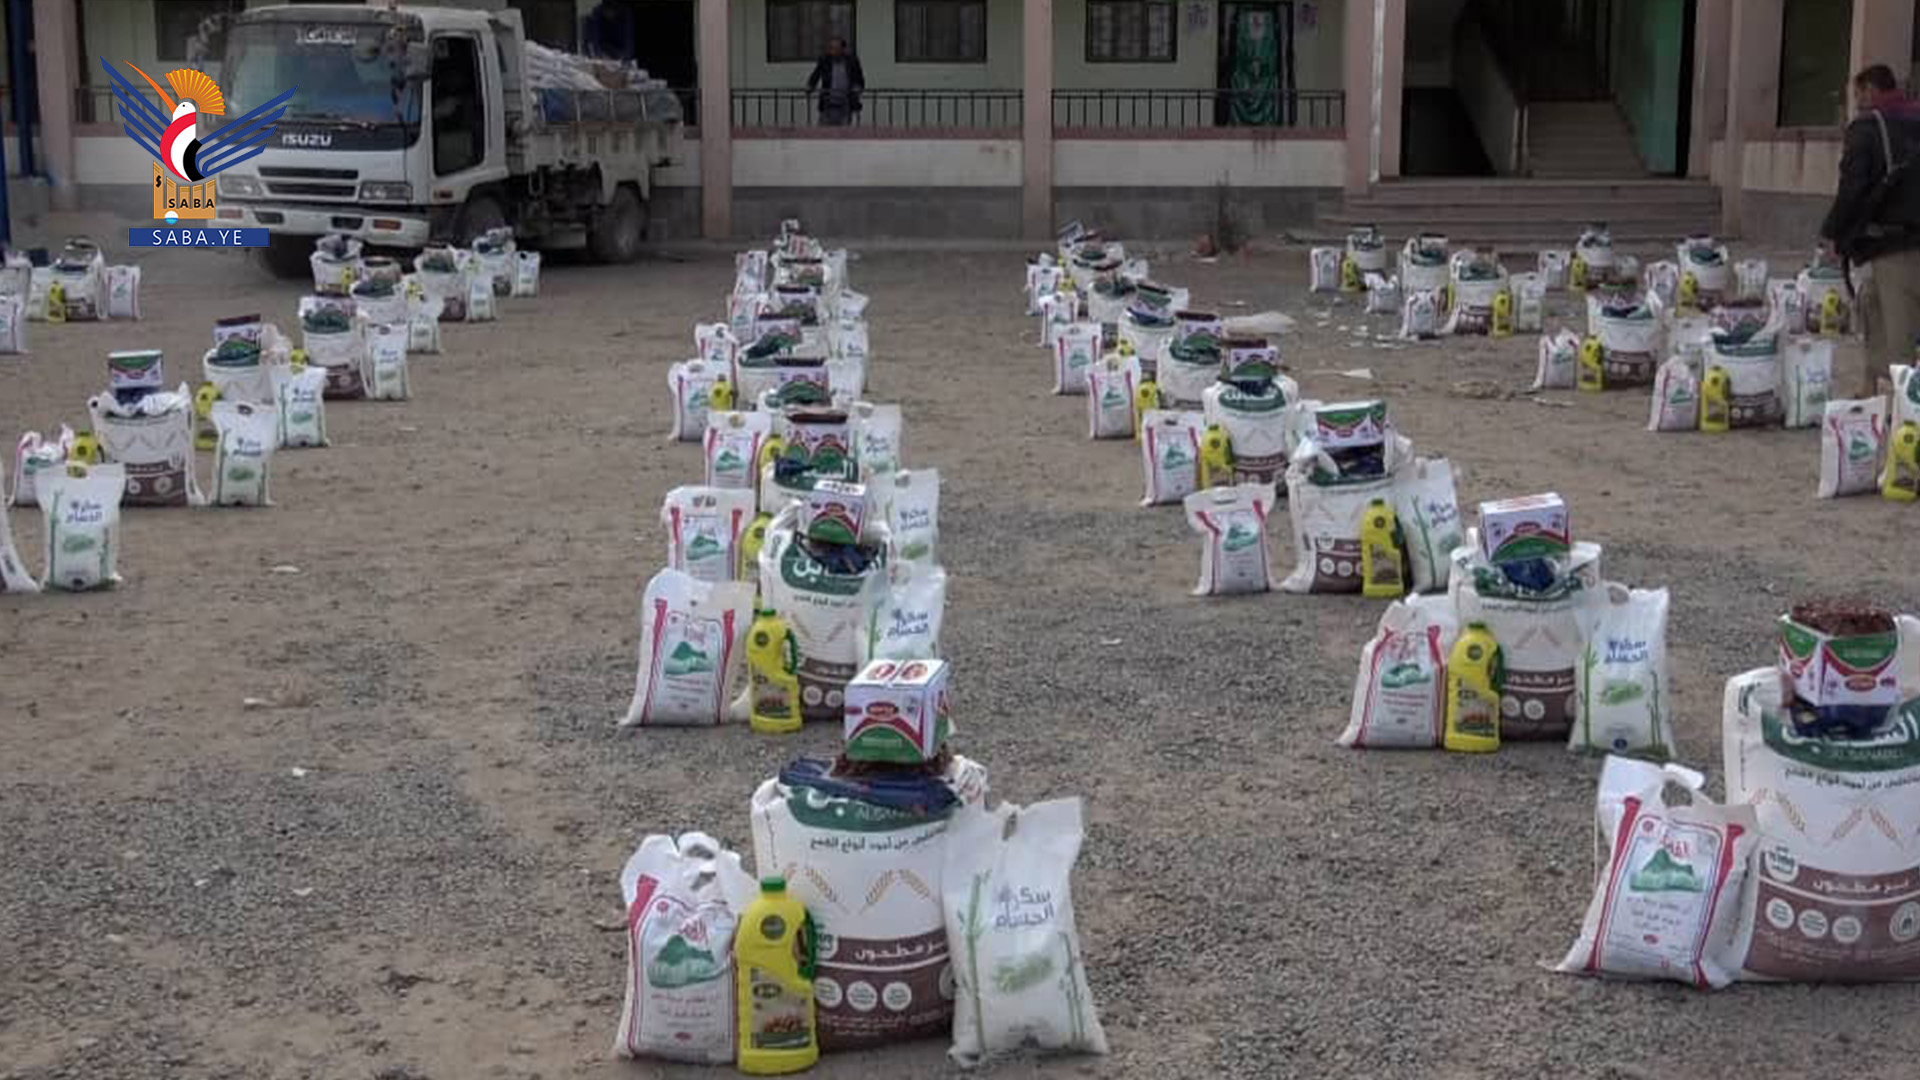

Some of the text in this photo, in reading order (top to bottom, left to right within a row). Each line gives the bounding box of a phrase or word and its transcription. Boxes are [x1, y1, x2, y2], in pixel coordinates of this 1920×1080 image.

[282, 134, 332, 147] ISUZU
[1011, 886, 1051, 910] سكر
[994, 902, 1054, 932] الحسام
